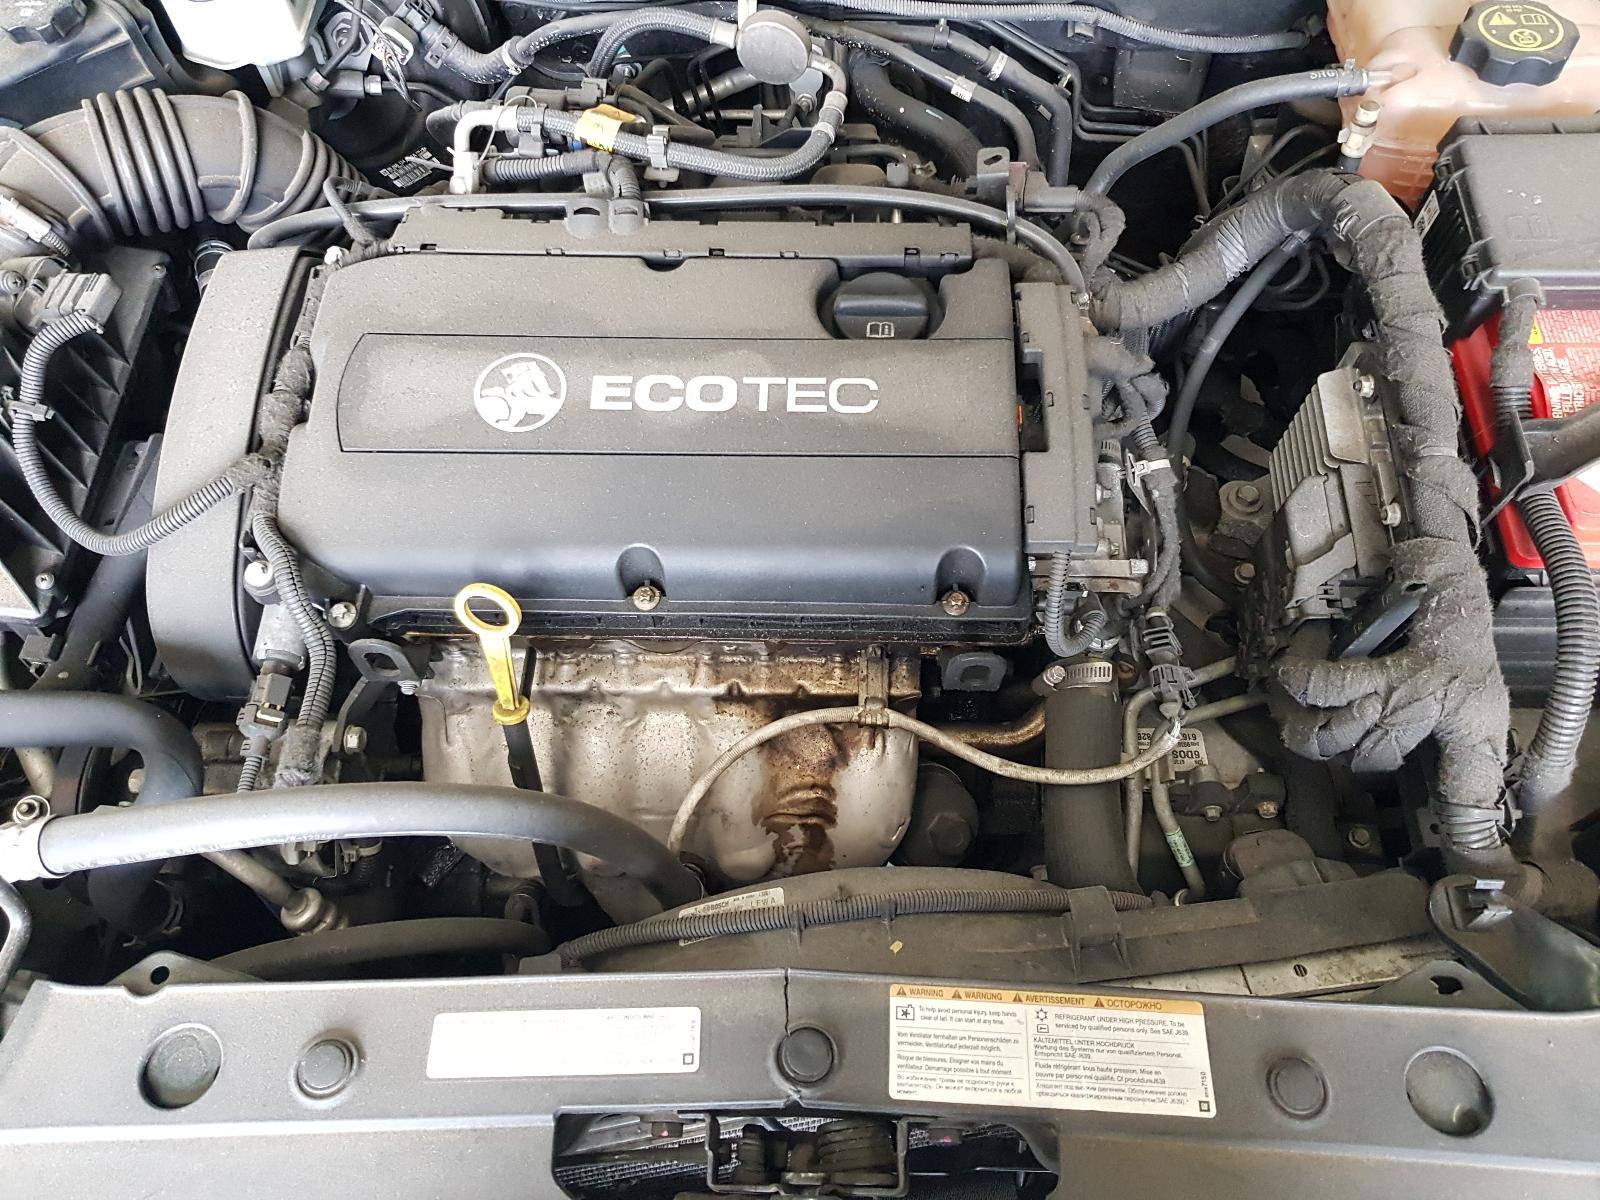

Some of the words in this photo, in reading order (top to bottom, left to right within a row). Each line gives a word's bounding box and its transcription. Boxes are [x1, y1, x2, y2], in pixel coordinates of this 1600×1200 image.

[590, 375, 879, 413] ECOTEC
[709, 901, 730, 912] BOSCH
[909, 988, 944, 998] WARNING
[965, 991, 1003, 1001] WARNUNG
[1025, 994, 1085, 1006] AVERTISSEMENT
[1107, 999, 1163, 1010] ОСТОРОЖНО
[952, 1008, 973, 1016] personal
[989, 1010, 1000, 1018] keep
[1054, 1013, 1096, 1022] REFRIGERANT
[1097, 1016, 1118, 1024] UNDER
[1079, 1024, 1087, 1032] by
[1088, 1024, 1112, 1033] qualified
[1034, 1037, 1073, 1046] KÄLTEMITTEL
[1096, 1040, 1136, 1049] HOCHDRUCK
[1034, 1044, 1058, 1052] Wartung
[1071, 1045, 1095, 1054] Systems
